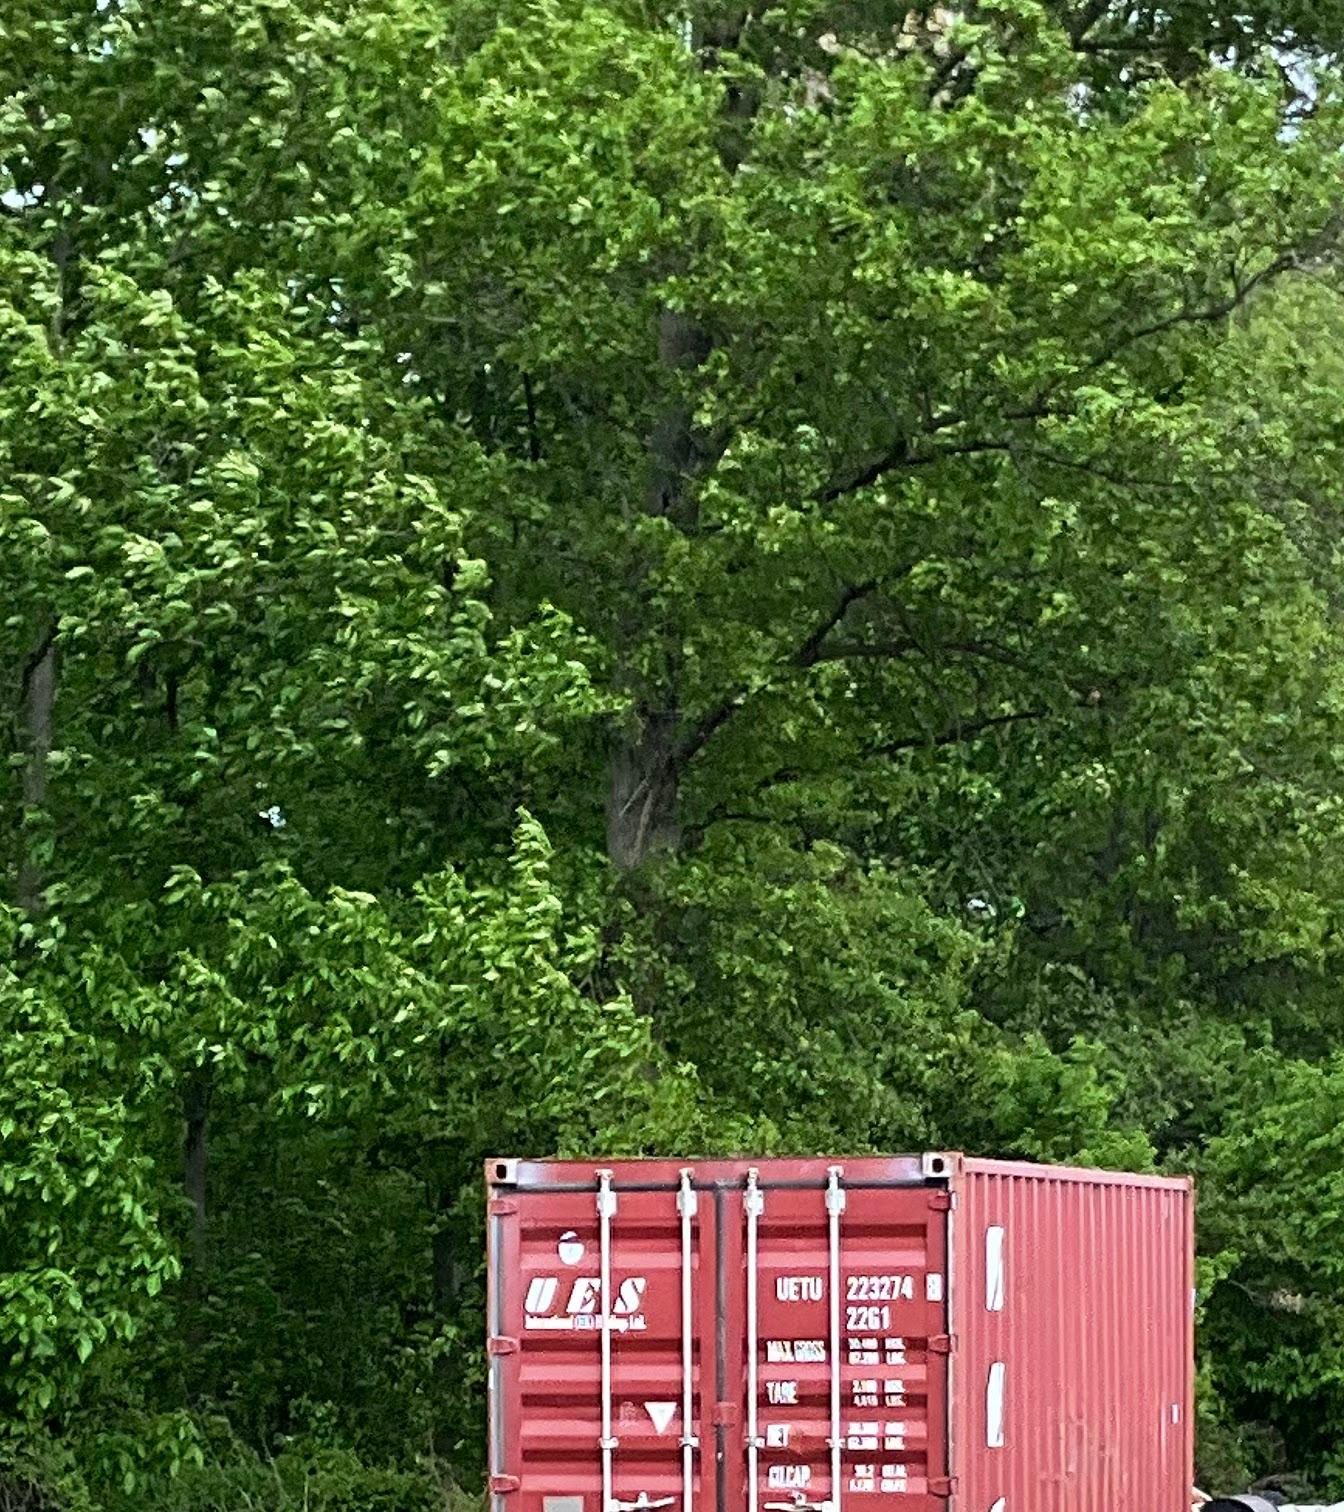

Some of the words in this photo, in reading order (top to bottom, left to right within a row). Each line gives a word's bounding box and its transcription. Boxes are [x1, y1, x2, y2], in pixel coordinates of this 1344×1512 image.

[524, 1277, 647, 1314] UES
[776, 1276, 824, 1301] UETU
[846, 1275, 914, 1301] 223274
